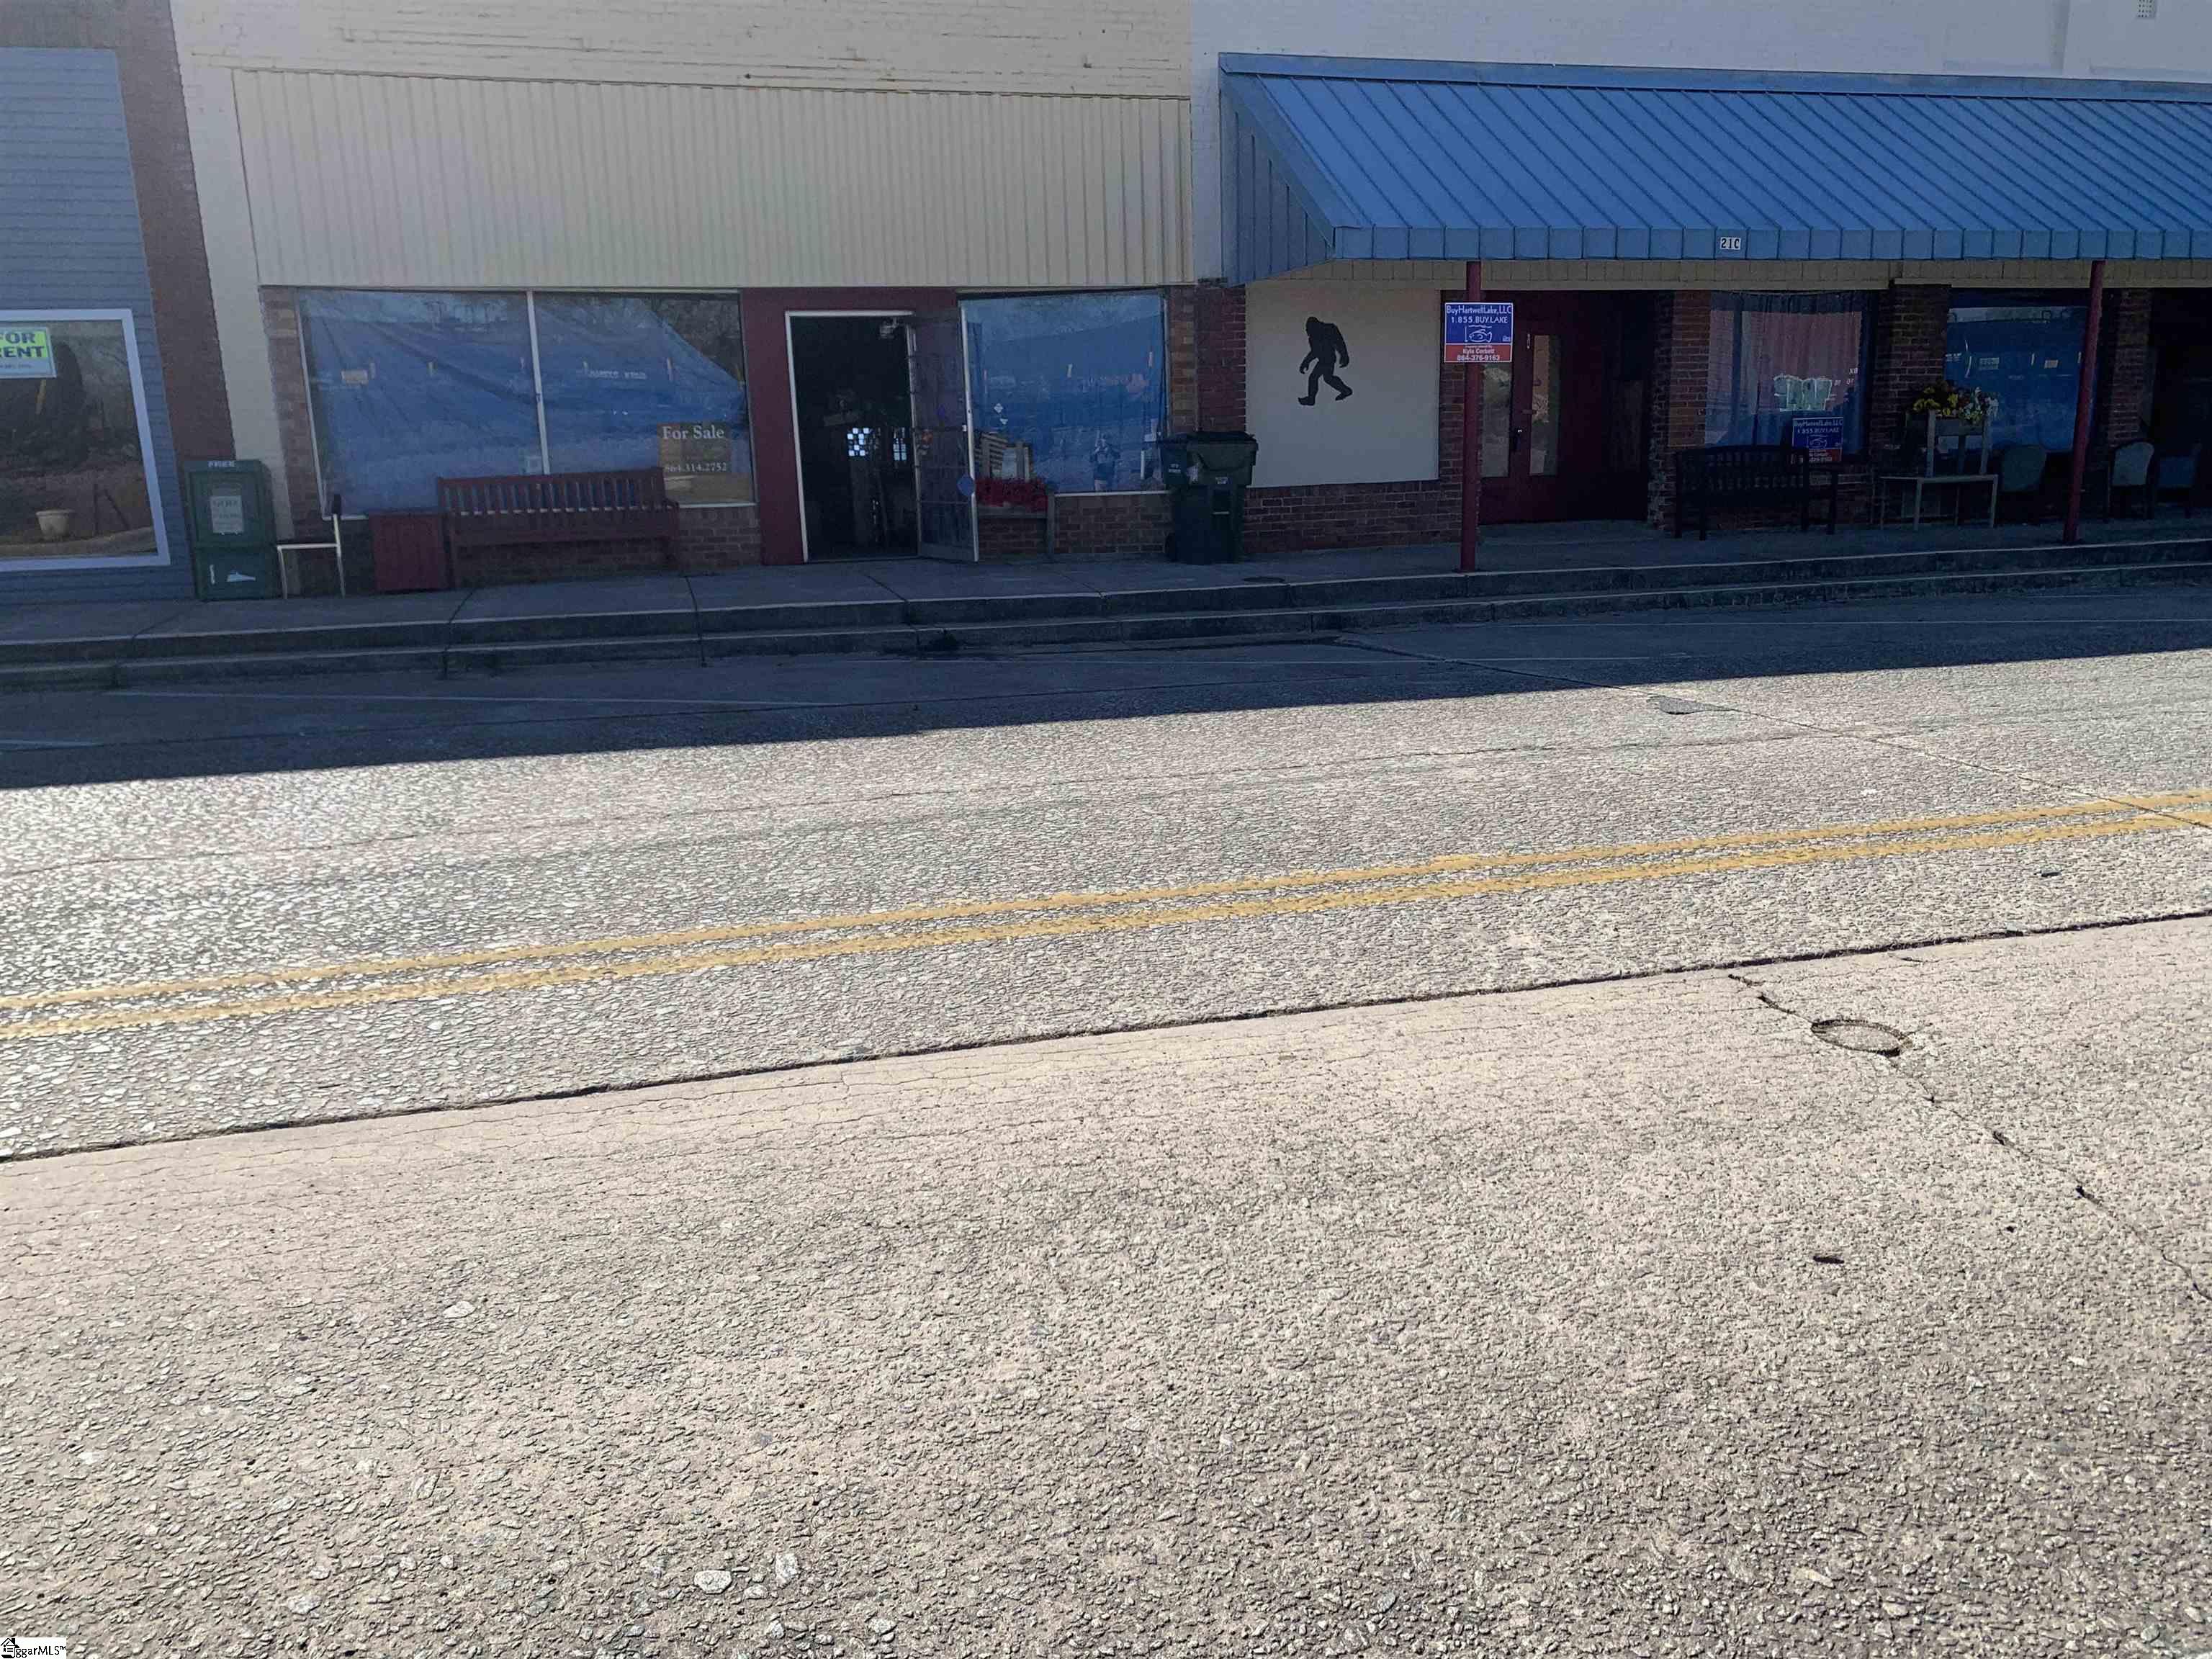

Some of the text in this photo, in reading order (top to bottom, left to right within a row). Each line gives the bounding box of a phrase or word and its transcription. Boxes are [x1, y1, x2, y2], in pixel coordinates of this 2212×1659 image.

[0, 346, 45, 358] ENT
[662, 424, 725, 439] For Sale
